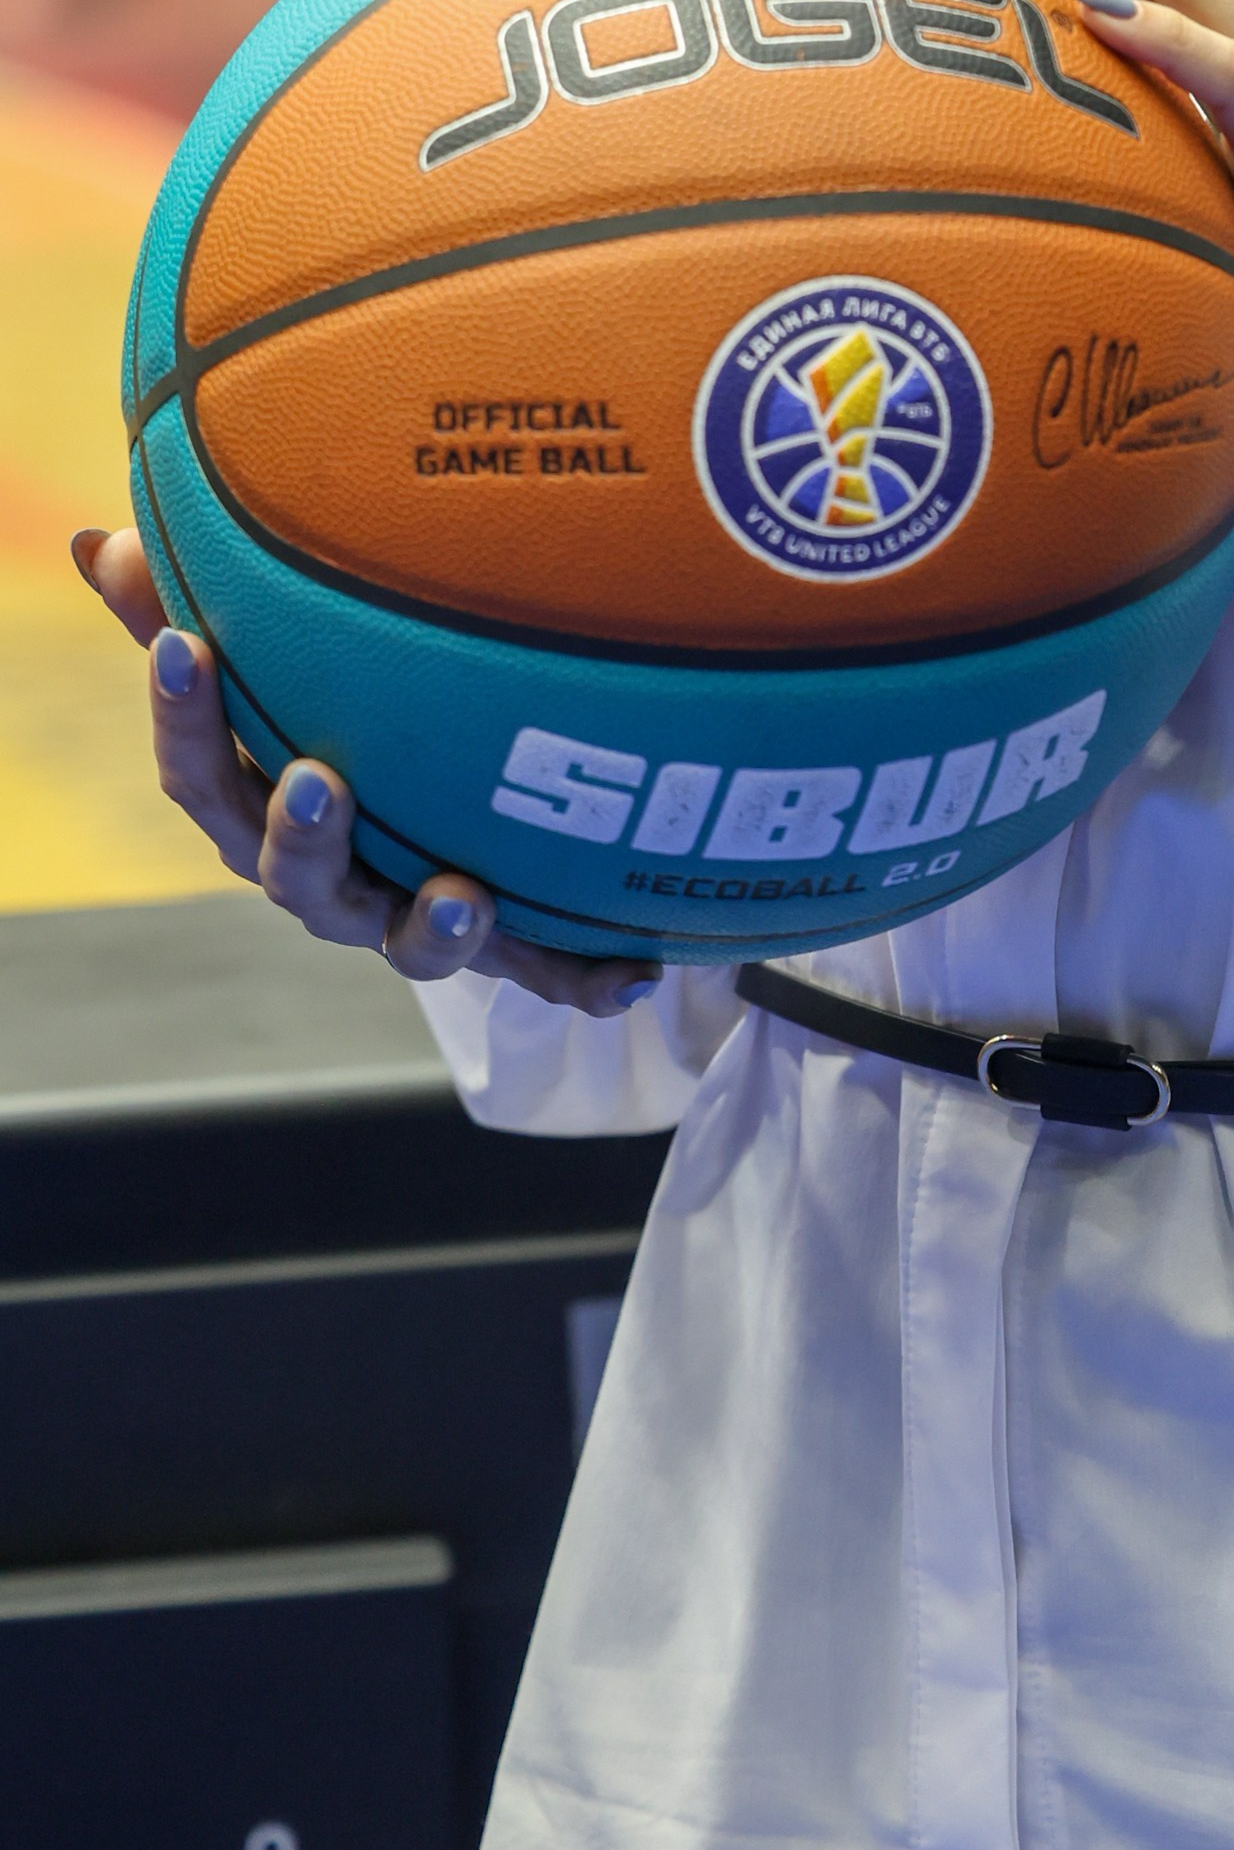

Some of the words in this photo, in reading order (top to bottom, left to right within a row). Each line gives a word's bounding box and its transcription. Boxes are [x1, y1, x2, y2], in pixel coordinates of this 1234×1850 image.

[736, 298, 836, 371] ЕДИНАЯ
[842, 296, 908, 331] ЛИГА
[909, 321, 950, 362] ВТБ
[434, 401, 621, 432] OFFICIAL
[415, 445, 524, 475] GAME
[540, 445, 647, 475] BALL
[745, 504, 786, 545] VTB
[785, 532, 871, 563] UNITED
[874, 494, 950, 557] LEAGUE
[491, 688, 1107, 860] SIBUR
[624, 870, 867, 900] #ECOBALL
[882, 850, 961, 888] 2.0
